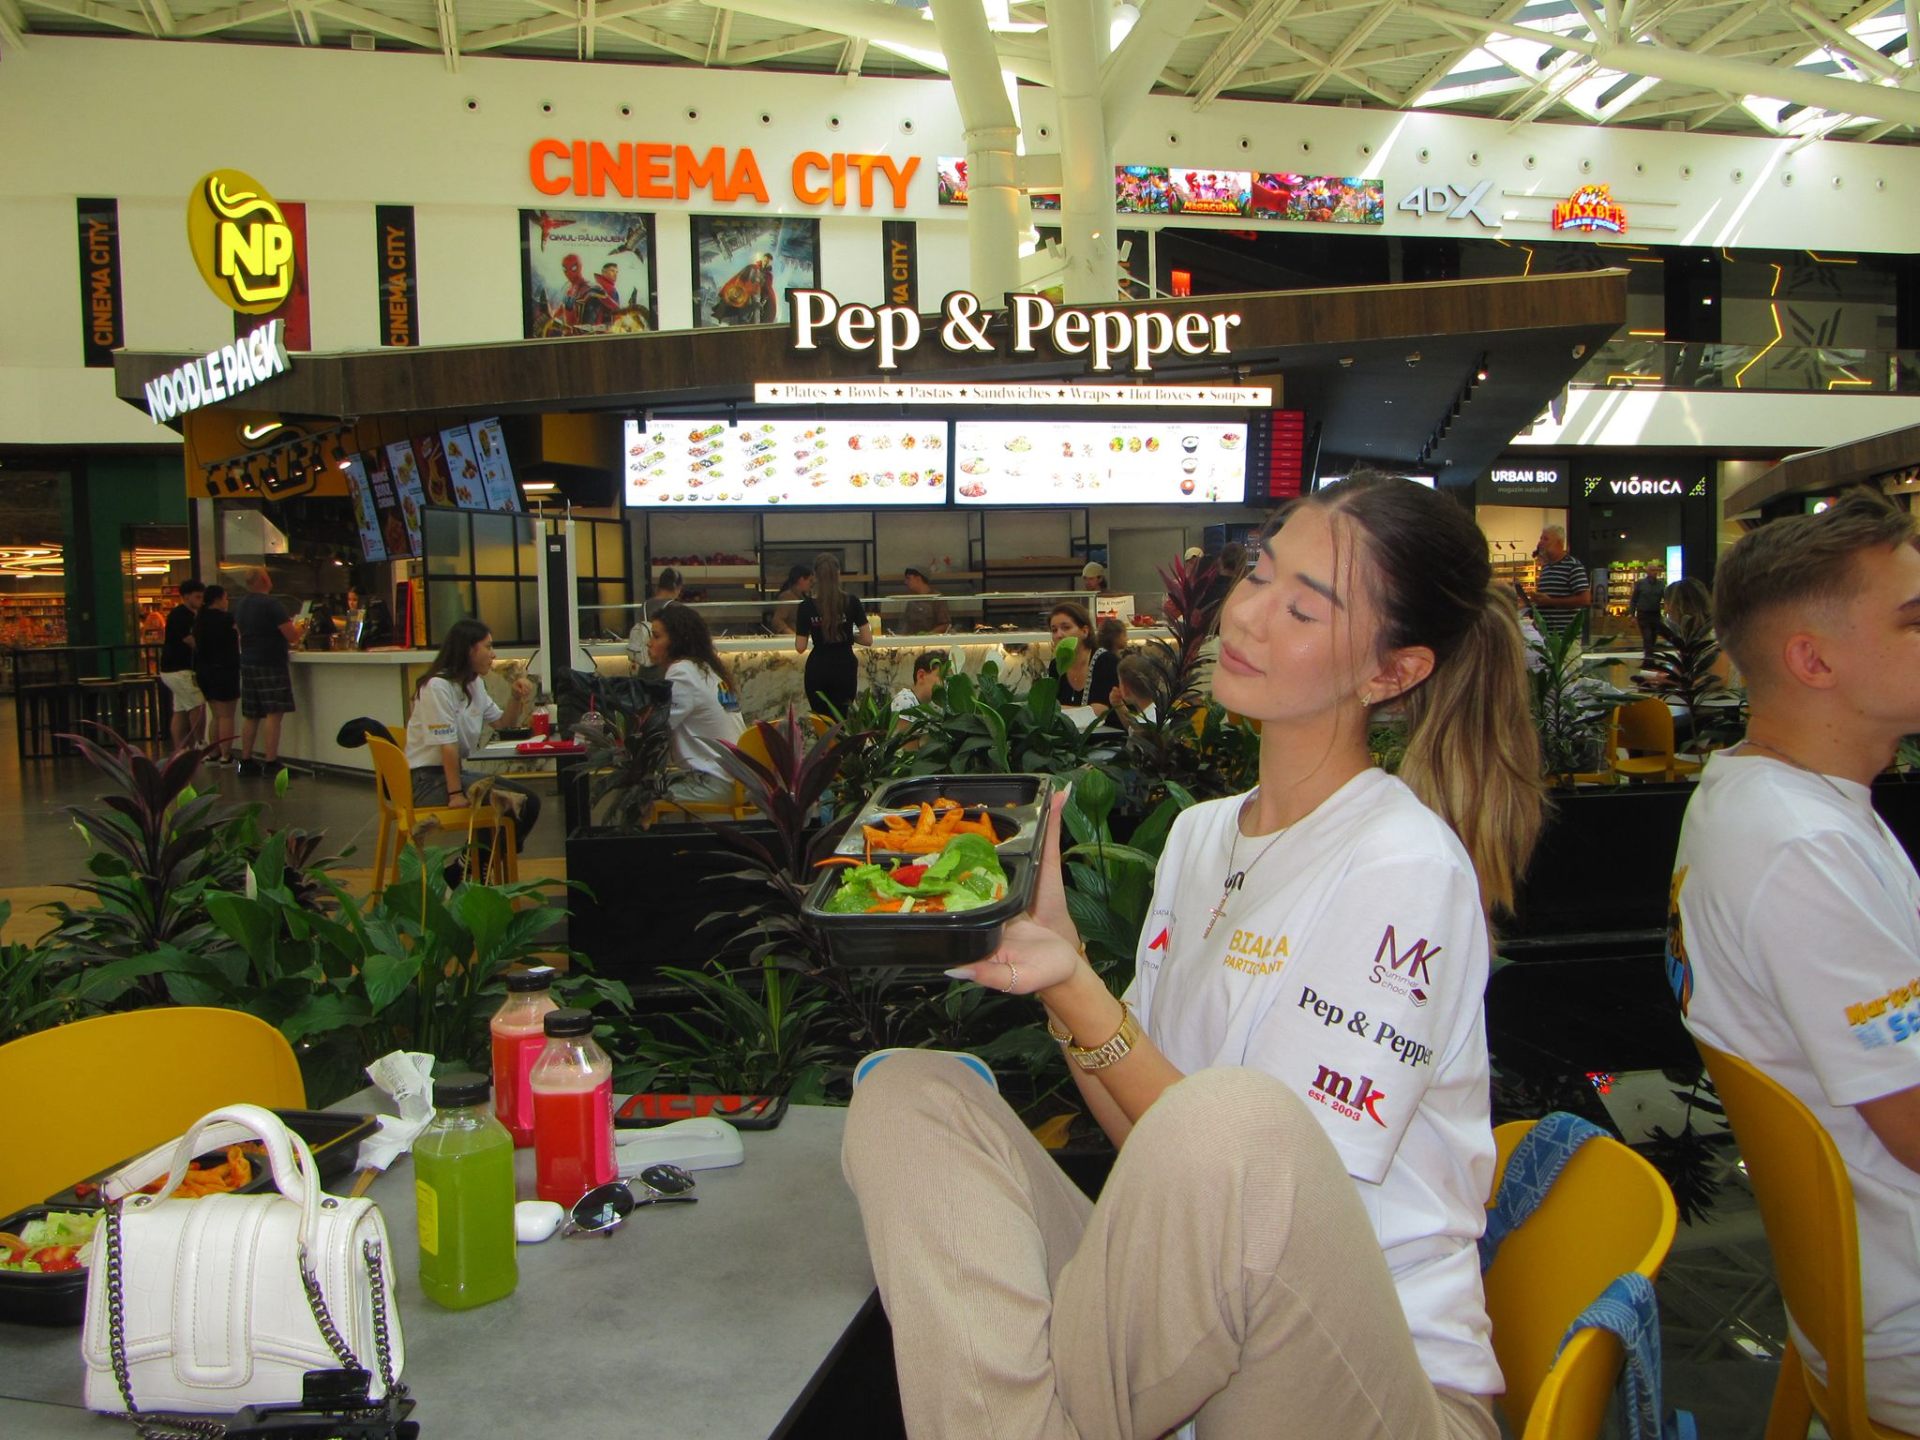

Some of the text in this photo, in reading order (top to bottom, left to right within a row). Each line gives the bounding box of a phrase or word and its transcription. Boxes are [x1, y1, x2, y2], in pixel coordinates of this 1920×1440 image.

[529, 138, 921, 208] CINEMA CITY
[1398, 180, 1502, 229] 4DX
[1556, 203, 1623, 226] MAXBET
[220, 222, 293, 276] NP
[891, 239, 909, 281] CITY
[88, 218, 114, 346] CINEMA CITY
[386, 226, 409, 347] CINEMA CITY
[792, 290, 1241, 371] Pep & Pepper
[785, 385, 1246, 404] Plates Bowls Pastas Sandwiches Wraps Hot Boxes Soups
[1491, 470, 1557, 483] URBAN BIO
[1374, 924, 1442, 985] MK
[1298, 985, 1433, 1067] Pep & Pepper
[1307, 1089, 1361, 1122] est. 2003
